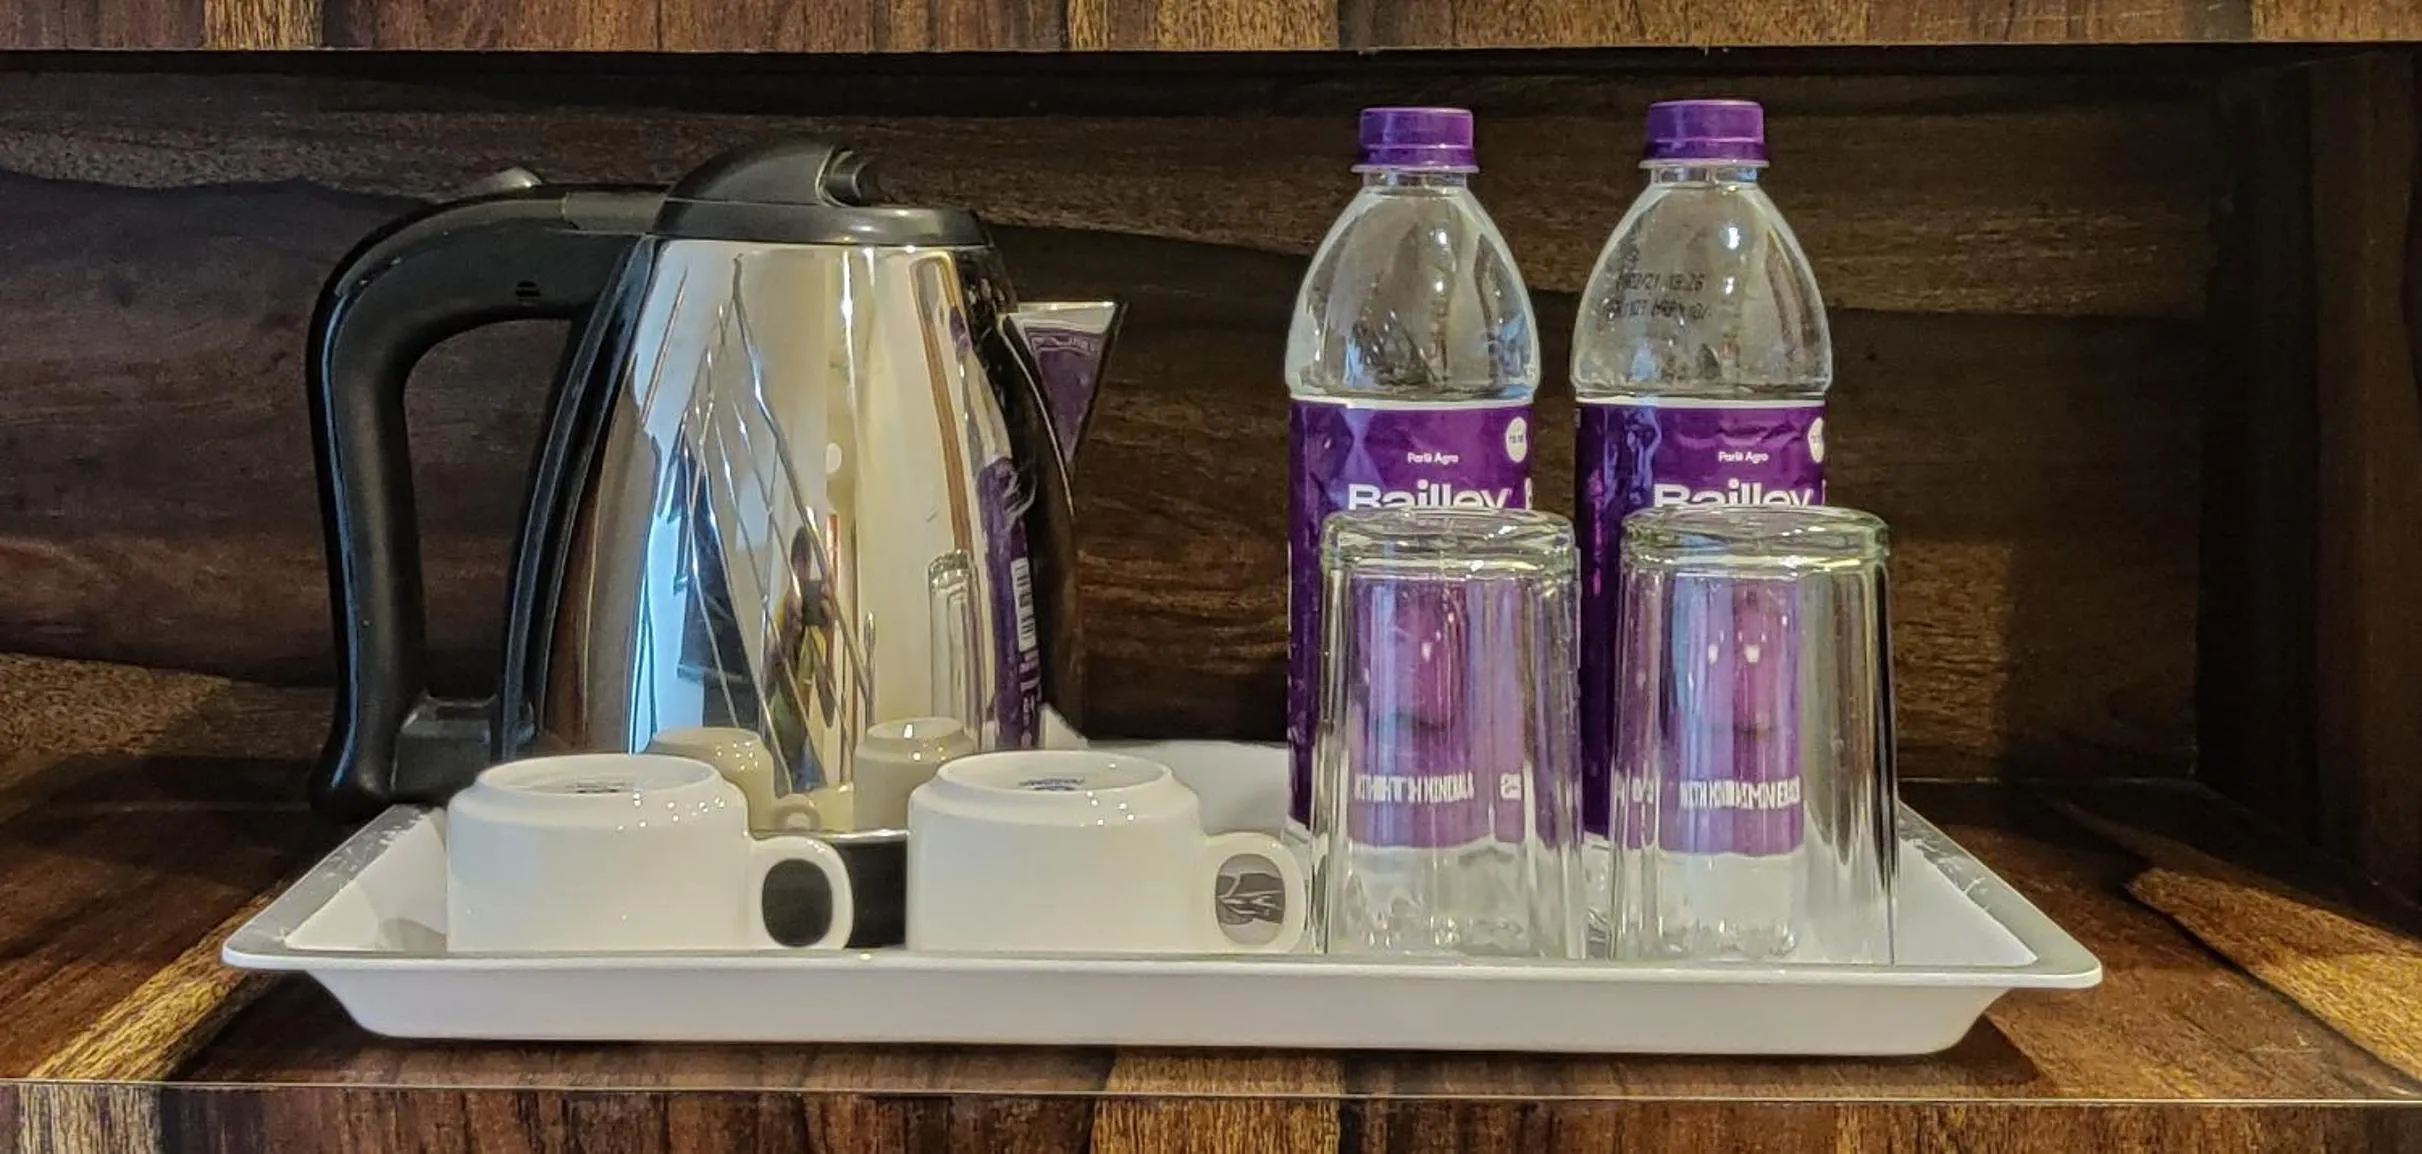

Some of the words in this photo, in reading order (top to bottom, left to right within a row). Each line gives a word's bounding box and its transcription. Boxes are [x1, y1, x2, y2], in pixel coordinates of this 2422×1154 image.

[1745, 451, 1769, 464] Agro
[1348, 478, 1512, 510] Bailley
[1653, 478, 1814, 506] Bailley
